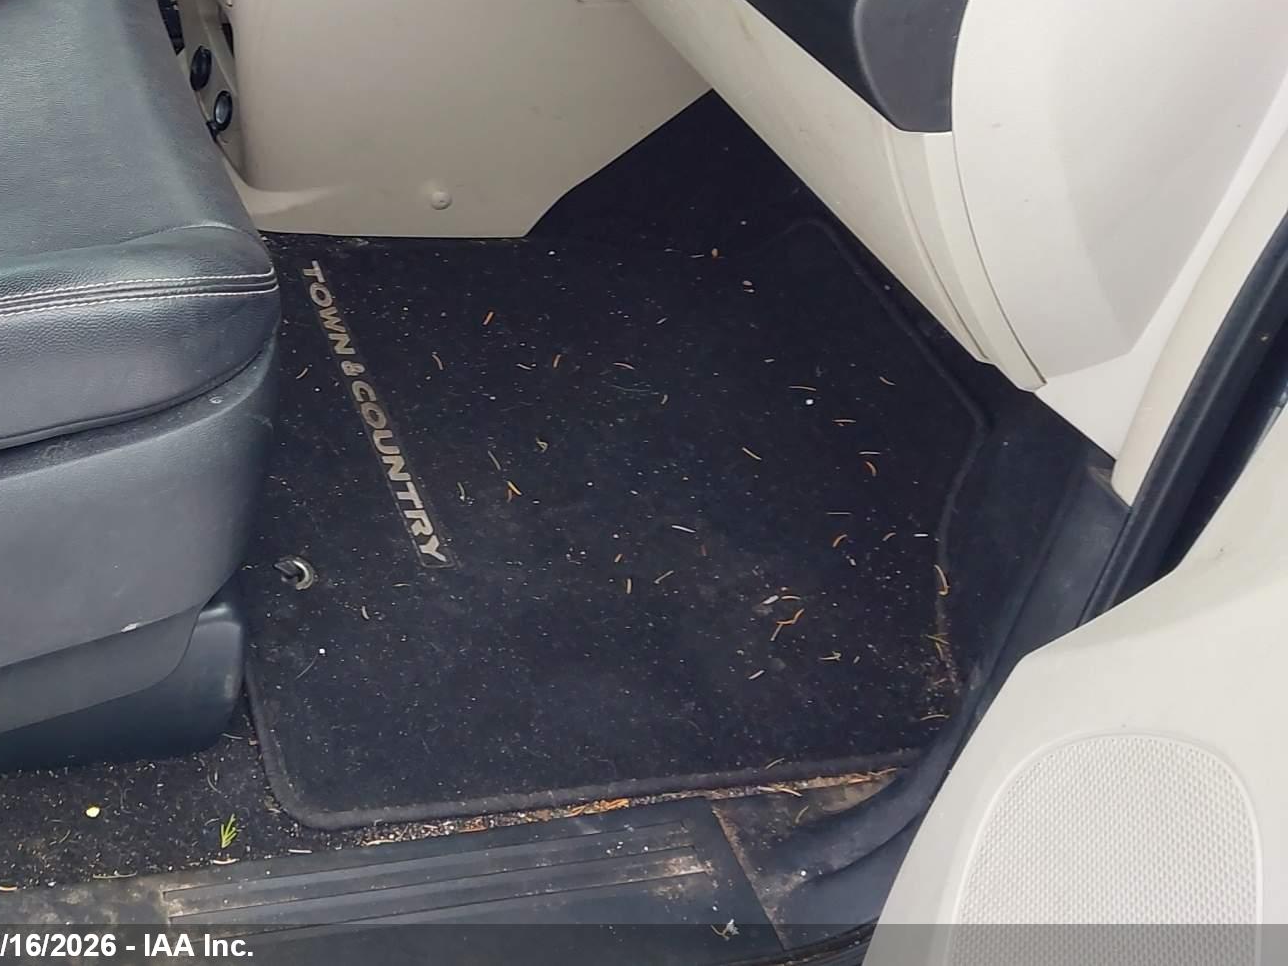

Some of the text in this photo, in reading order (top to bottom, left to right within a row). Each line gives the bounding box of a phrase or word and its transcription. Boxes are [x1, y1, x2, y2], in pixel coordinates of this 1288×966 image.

[302, 260, 447, 563] TOWN & COUNTRY
